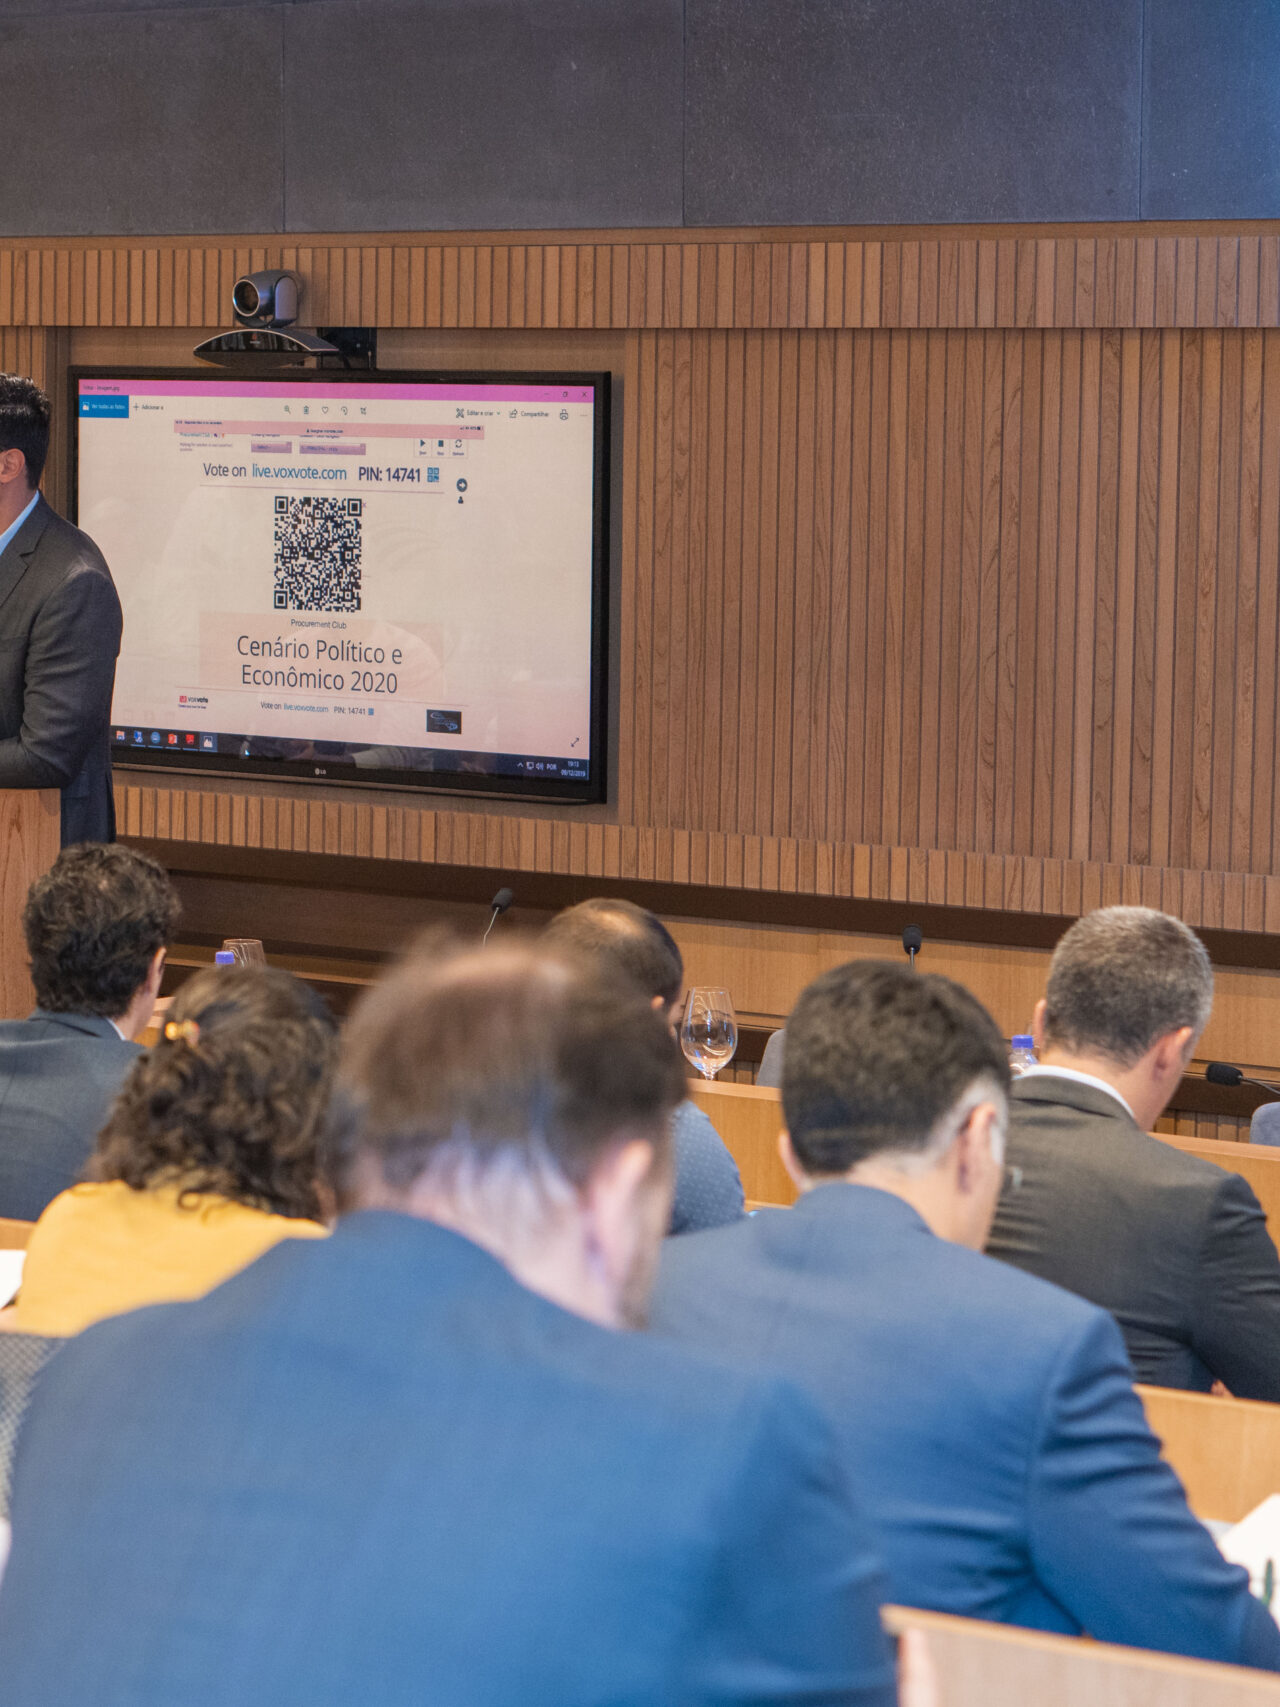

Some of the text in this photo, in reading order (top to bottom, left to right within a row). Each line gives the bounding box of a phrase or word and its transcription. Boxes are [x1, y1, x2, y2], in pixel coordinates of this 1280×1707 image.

[203, 463, 420, 483] Vote on live.voxvote.com PIN: 14741
[291, 619, 347, 630] Procurement Club
[237, 635, 403, 665] Cenário Político e
[242, 664, 398, 694] Econômico 2020
[260, 701, 273, 710] Vote
[333, 705, 346, 714] PIN:
[348, 706, 366, 715] 14741
